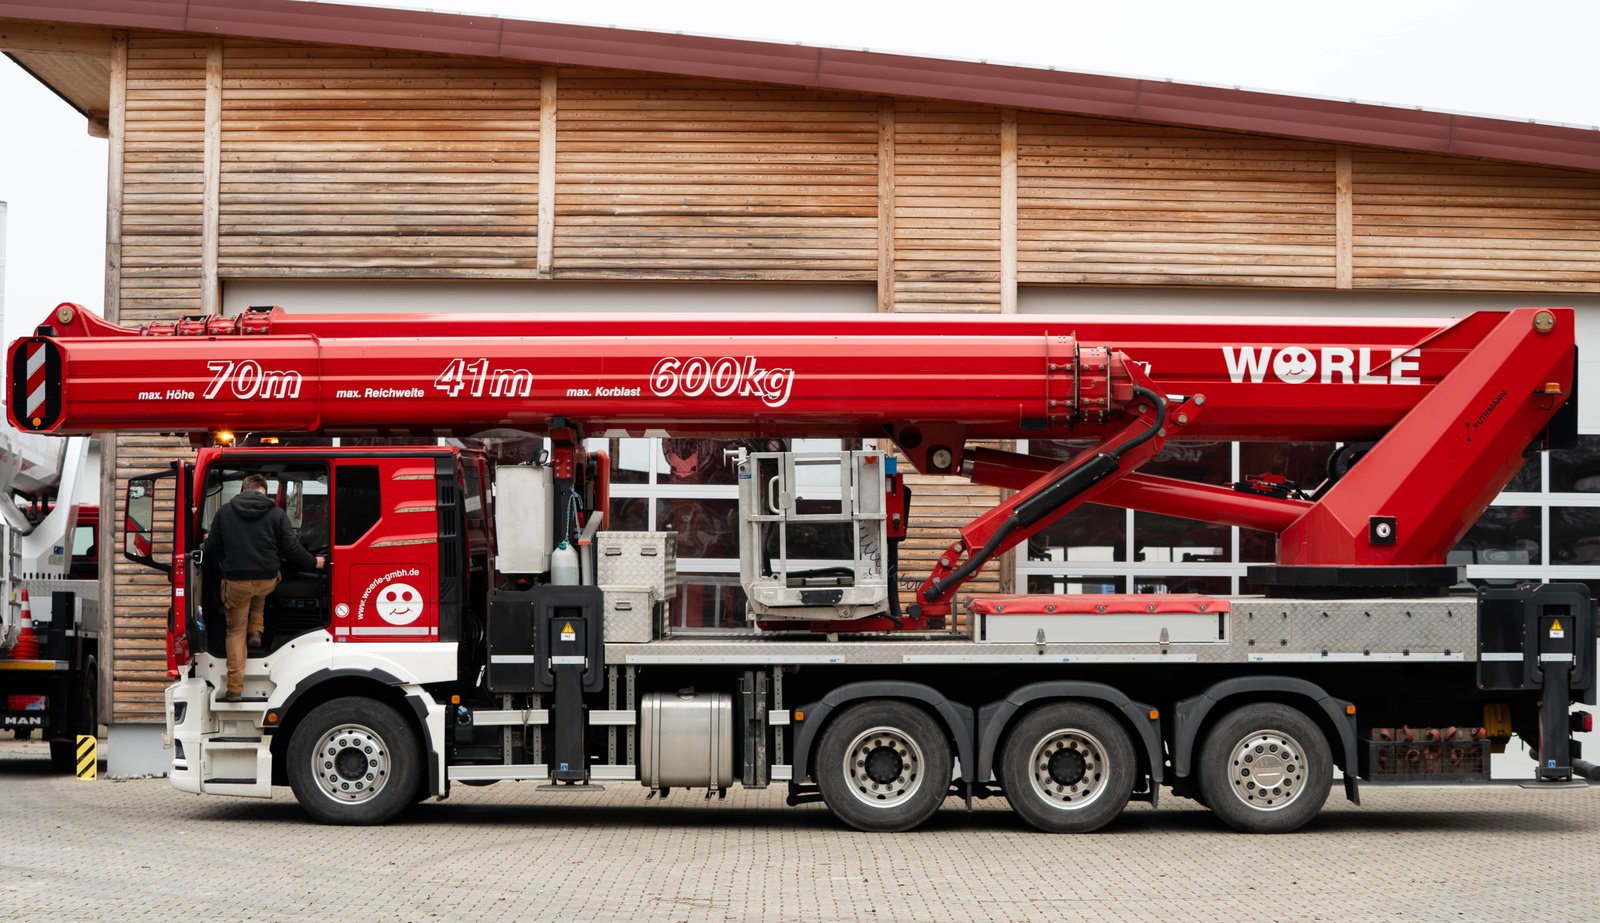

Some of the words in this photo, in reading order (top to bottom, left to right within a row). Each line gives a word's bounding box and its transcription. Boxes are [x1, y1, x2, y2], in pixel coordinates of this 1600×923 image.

[138, 390, 163, 400] max.
[166, 389, 195, 400] Höhe
[202, 359, 302, 399] 70m
[336, 388, 361, 398] max.
[364, 387, 425, 398] Reichweite
[434, 358, 533, 397] 41m
[566, 387, 592, 397] max.
[595, 386, 641, 397] Korblast
[650, 355, 795, 408] 600kg
[1472, 389, 1508, 430] RUTHMANN
[357, 567, 420, 620] www.woerle-gmbh.de
[5, 716, 42, 725] MAN
